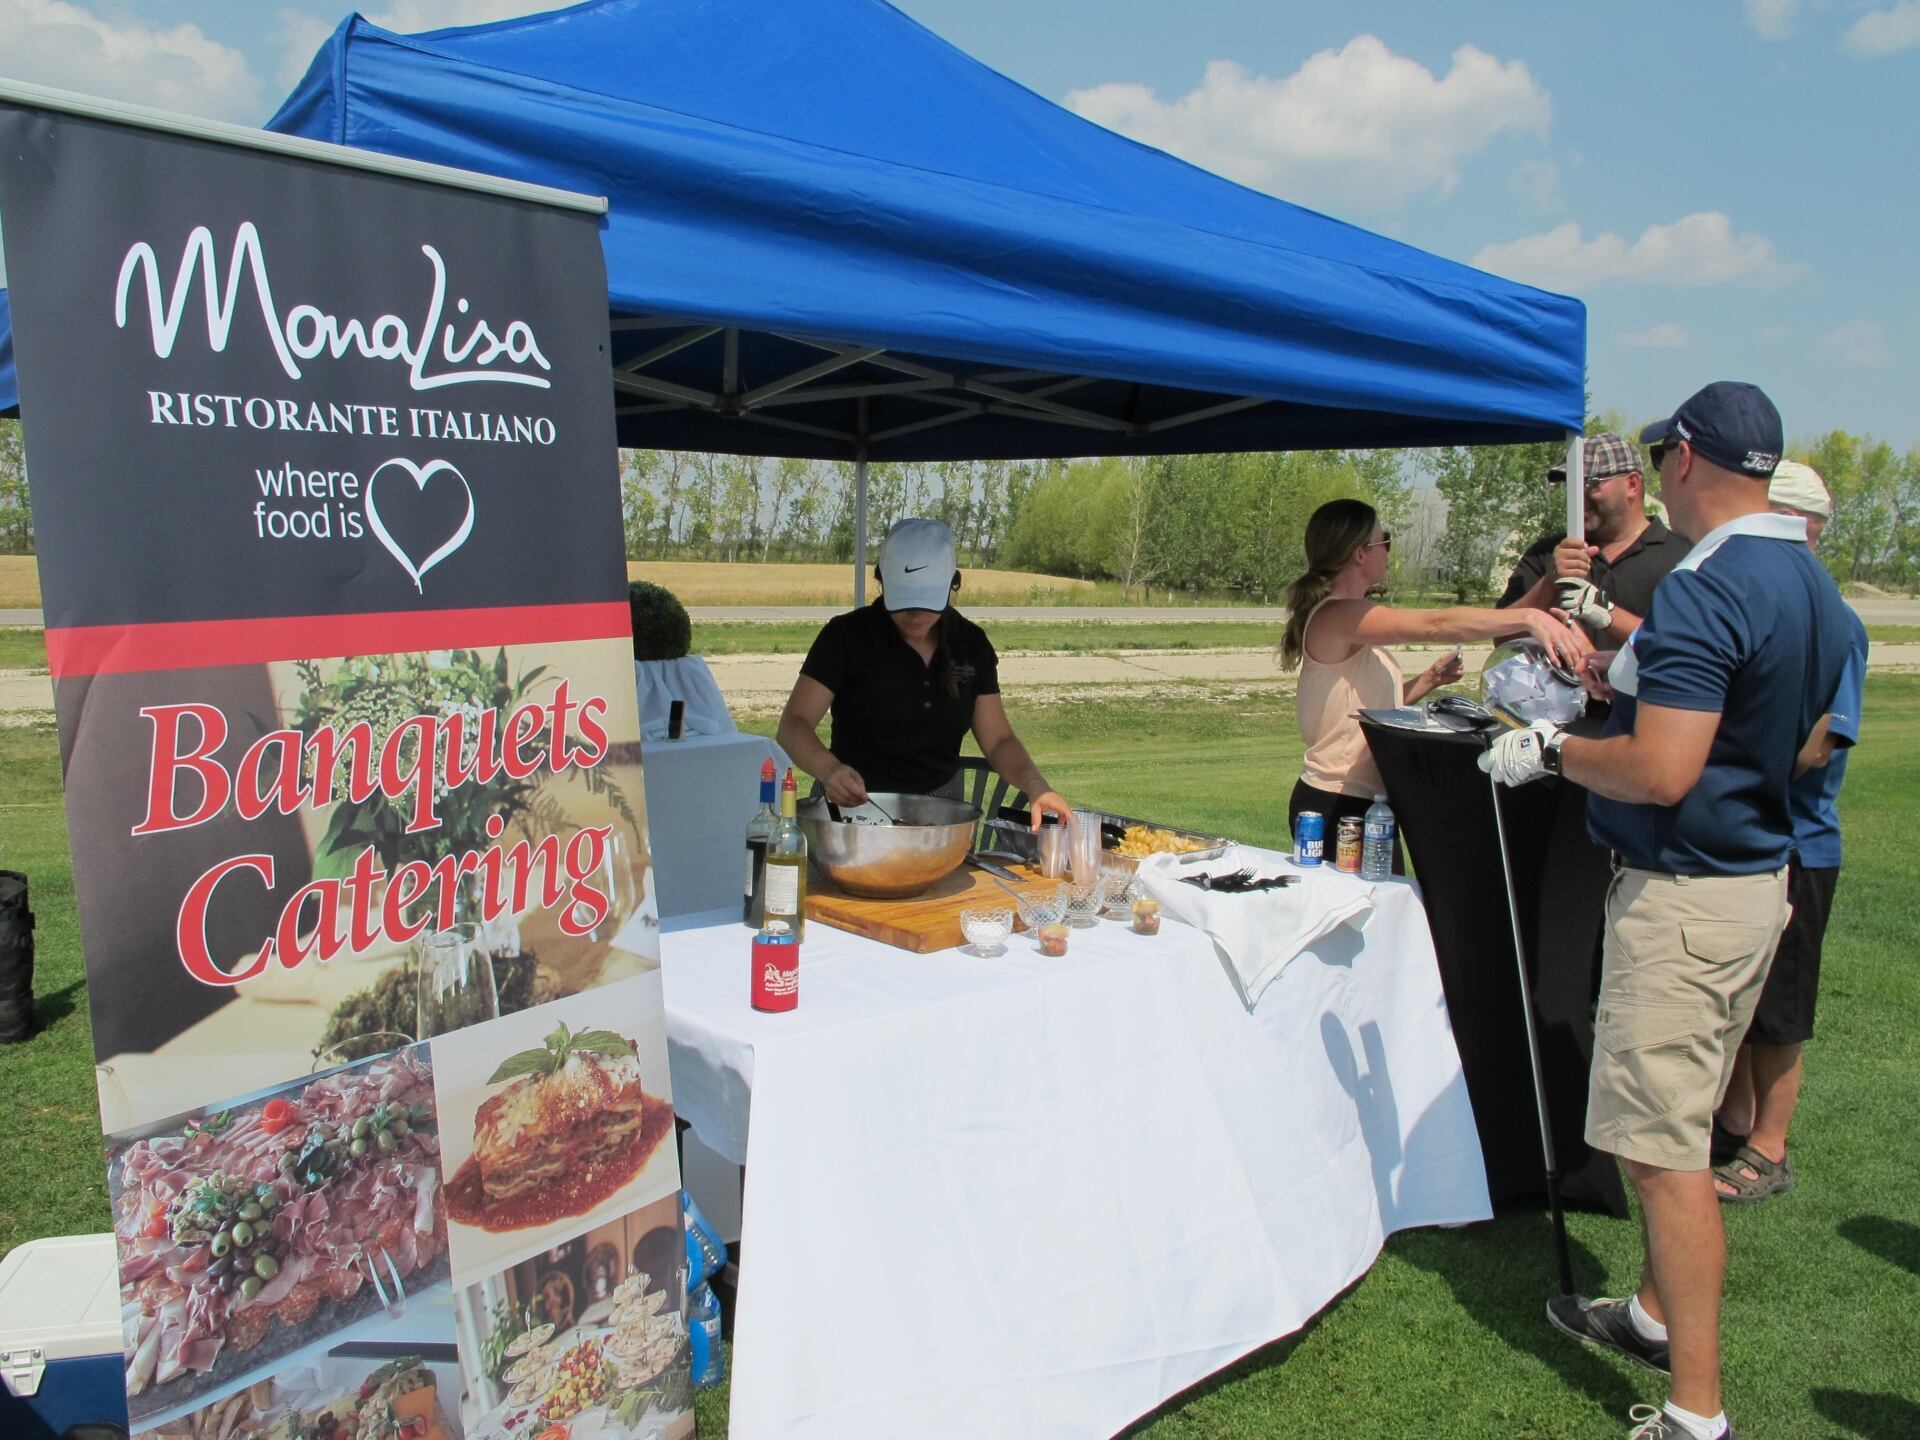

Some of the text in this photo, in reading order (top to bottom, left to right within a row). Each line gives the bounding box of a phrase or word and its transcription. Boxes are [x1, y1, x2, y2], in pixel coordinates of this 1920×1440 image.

[147, 390, 556, 445] RISTORANTE ITALIANO
[255, 461, 359, 499] where
[253, 502, 364, 539] food is
[131, 678, 609, 836] Banquets
[1301, 848, 1323, 858] LIG
[176, 814, 614, 988] Catering
